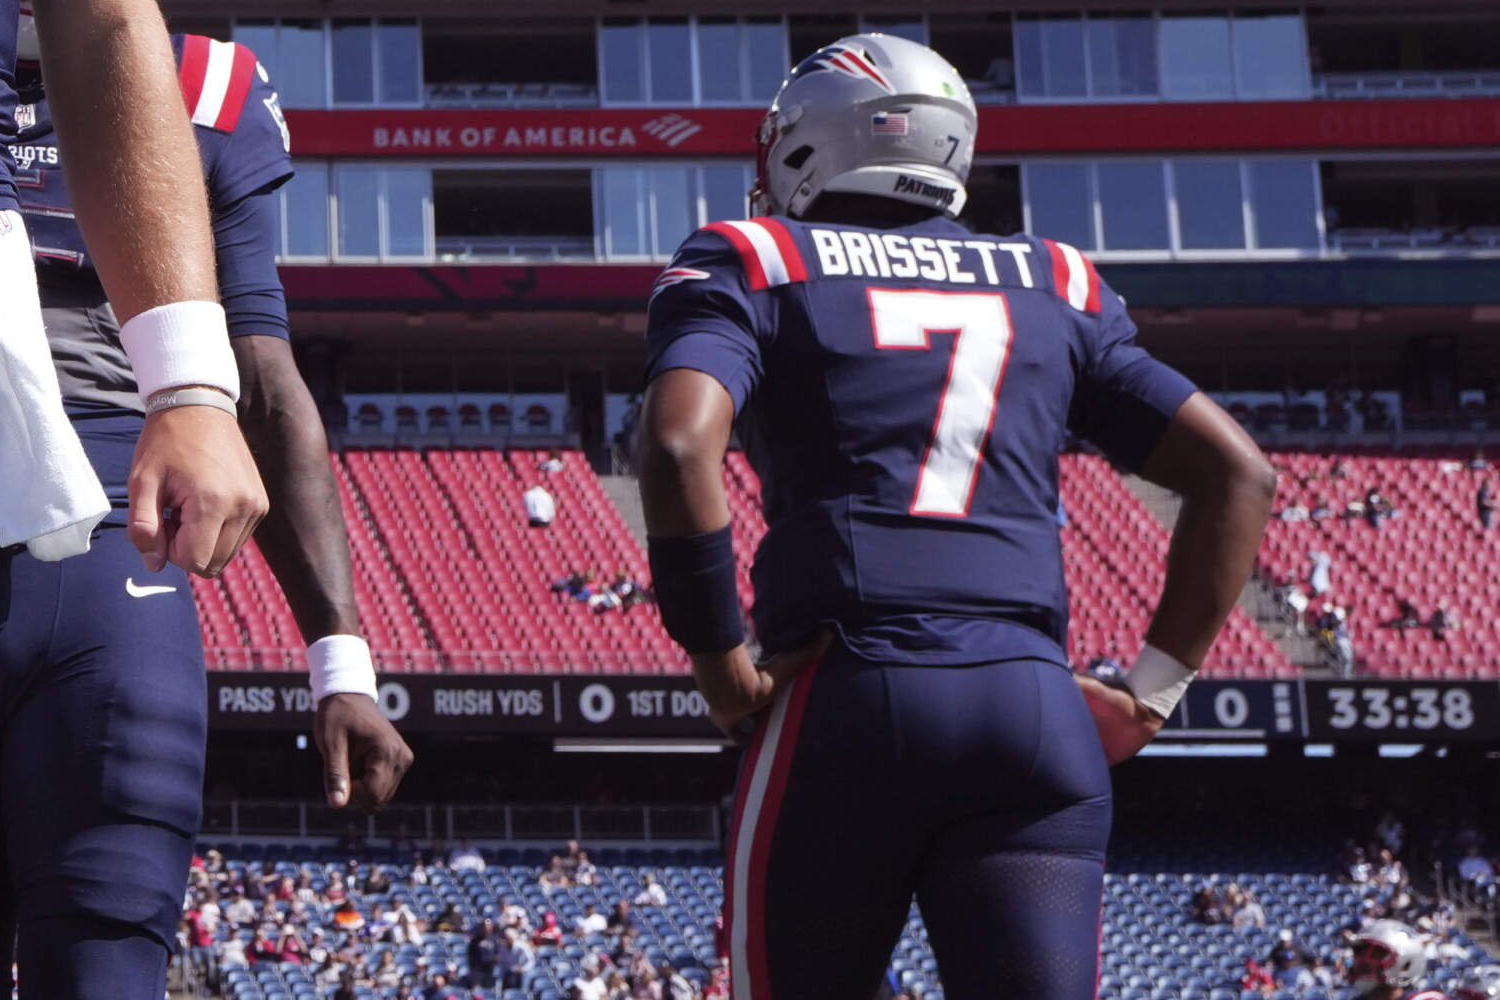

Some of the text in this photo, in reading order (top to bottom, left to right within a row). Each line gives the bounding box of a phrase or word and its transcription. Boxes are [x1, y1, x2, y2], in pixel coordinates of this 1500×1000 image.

[8, 145, 59, 165] RIOTS
[373, 126, 637, 148] BANK OF AMERICA
[944, 135, 960, 166] 7
[811, 229, 1034, 289] BRISSETT
[866, 286, 1014, 518] 7
[219, 687, 276, 713] PASS
[377, 682, 411, 722] 0
[433, 689, 493, 716] RUSH
[496, 690, 543, 716] YDS
[578, 684, 615, 723] 0
[627, 690, 666, 717] 1ST
[1214, 688, 1474, 729] 0 33:38
